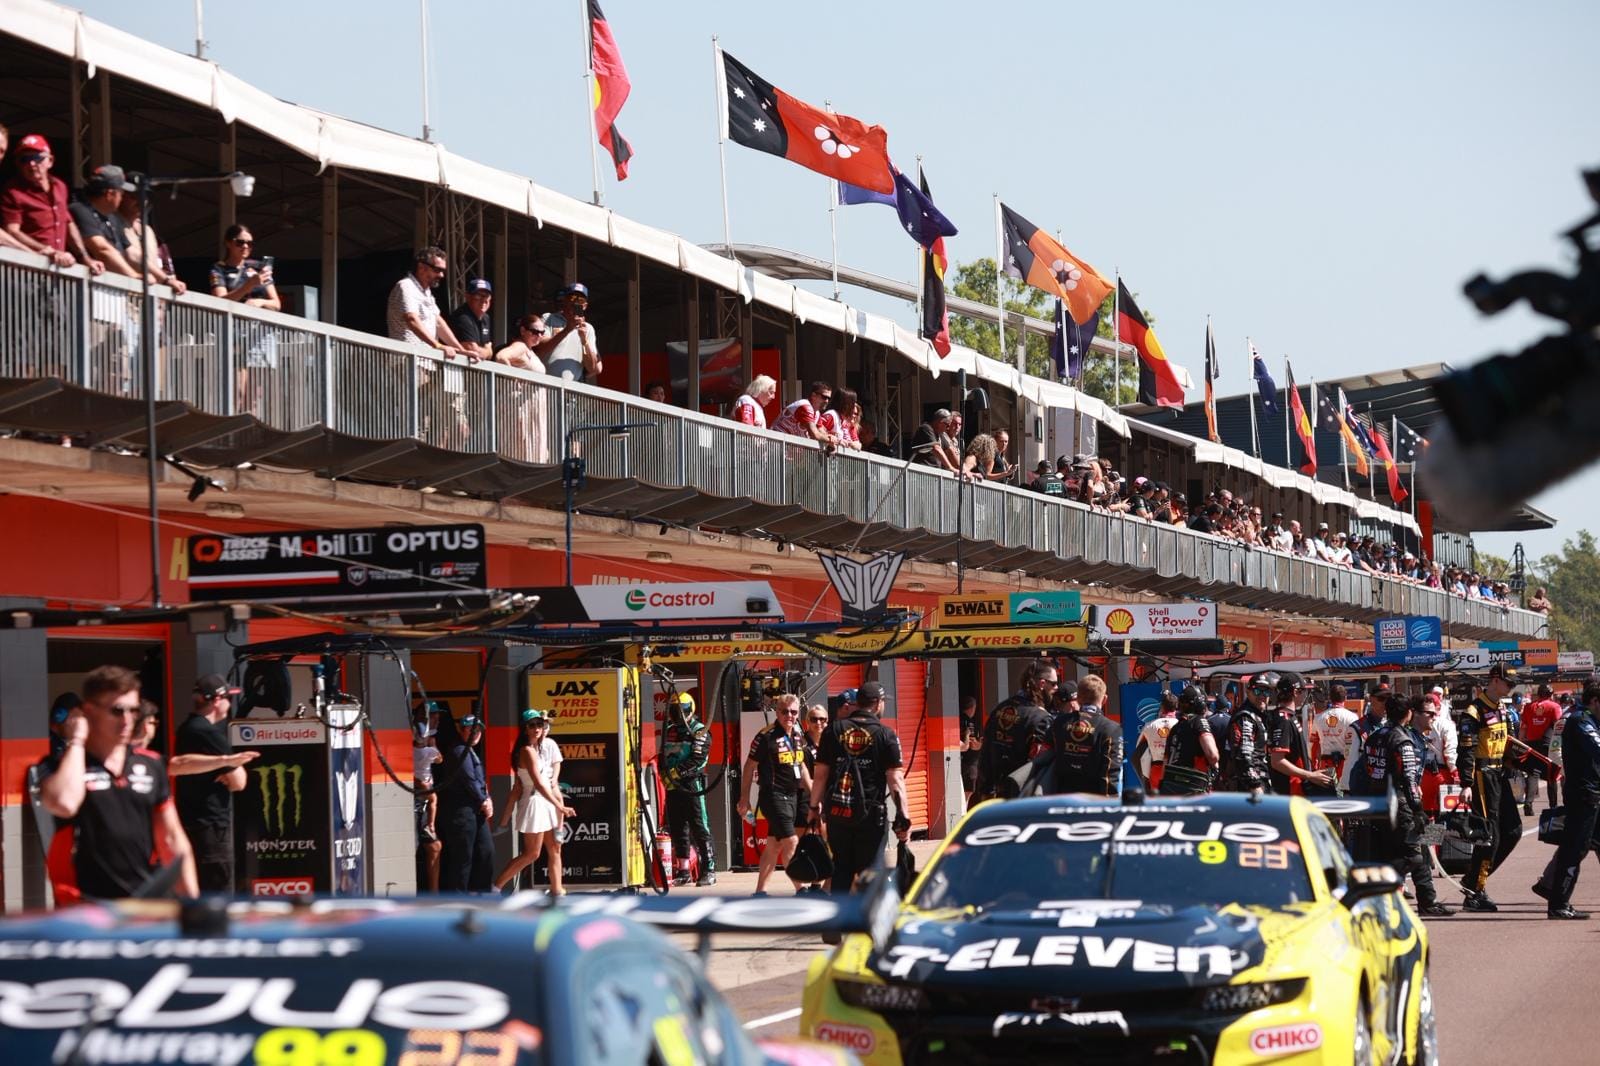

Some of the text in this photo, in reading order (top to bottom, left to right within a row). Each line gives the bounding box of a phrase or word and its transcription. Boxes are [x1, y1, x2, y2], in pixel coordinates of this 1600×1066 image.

[222, 537, 270, 549] TRUCK
[280, 534, 346, 558] Mobil
[387, 530, 479, 553] OPTUS
[219, 549, 268, 561] ASSIST
[649, 591, 715, 608] Castrol
[1148, 607, 1170, 616] Shell
[1149, 617, 1204, 627] V-Power
[683, 644, 731, 655] TYRES
[744, 642, 785, 654] AUTO
[927, 634, 1076, 649] JAX TYRES & AUTO
[546, 680, 599, 696] JAX
[552, 698, 600, 707] TYRES
[548, 708, 598, 718] & AUTO
[256, 728, 317, 741] Air Liquide
[1048, 806, 1211, 814] CHEVROLET
[575, 822, 609, 835] AIR
[965, 815, 1280, 846] erebus
[246, 839, 317, 852] MONSTER
[1197, 841, 1228, 864] 9
[1239, 843, 1289, 870] 23
[254, 881, 312, 896] RYCO
[0, 963, 510, 1031] ebus
[818, 1027, 1319, 1050] CHIKO CHIKO
[53, 1028, 254, 1066] Murray
[254, 1027, 387, 1066] 99
